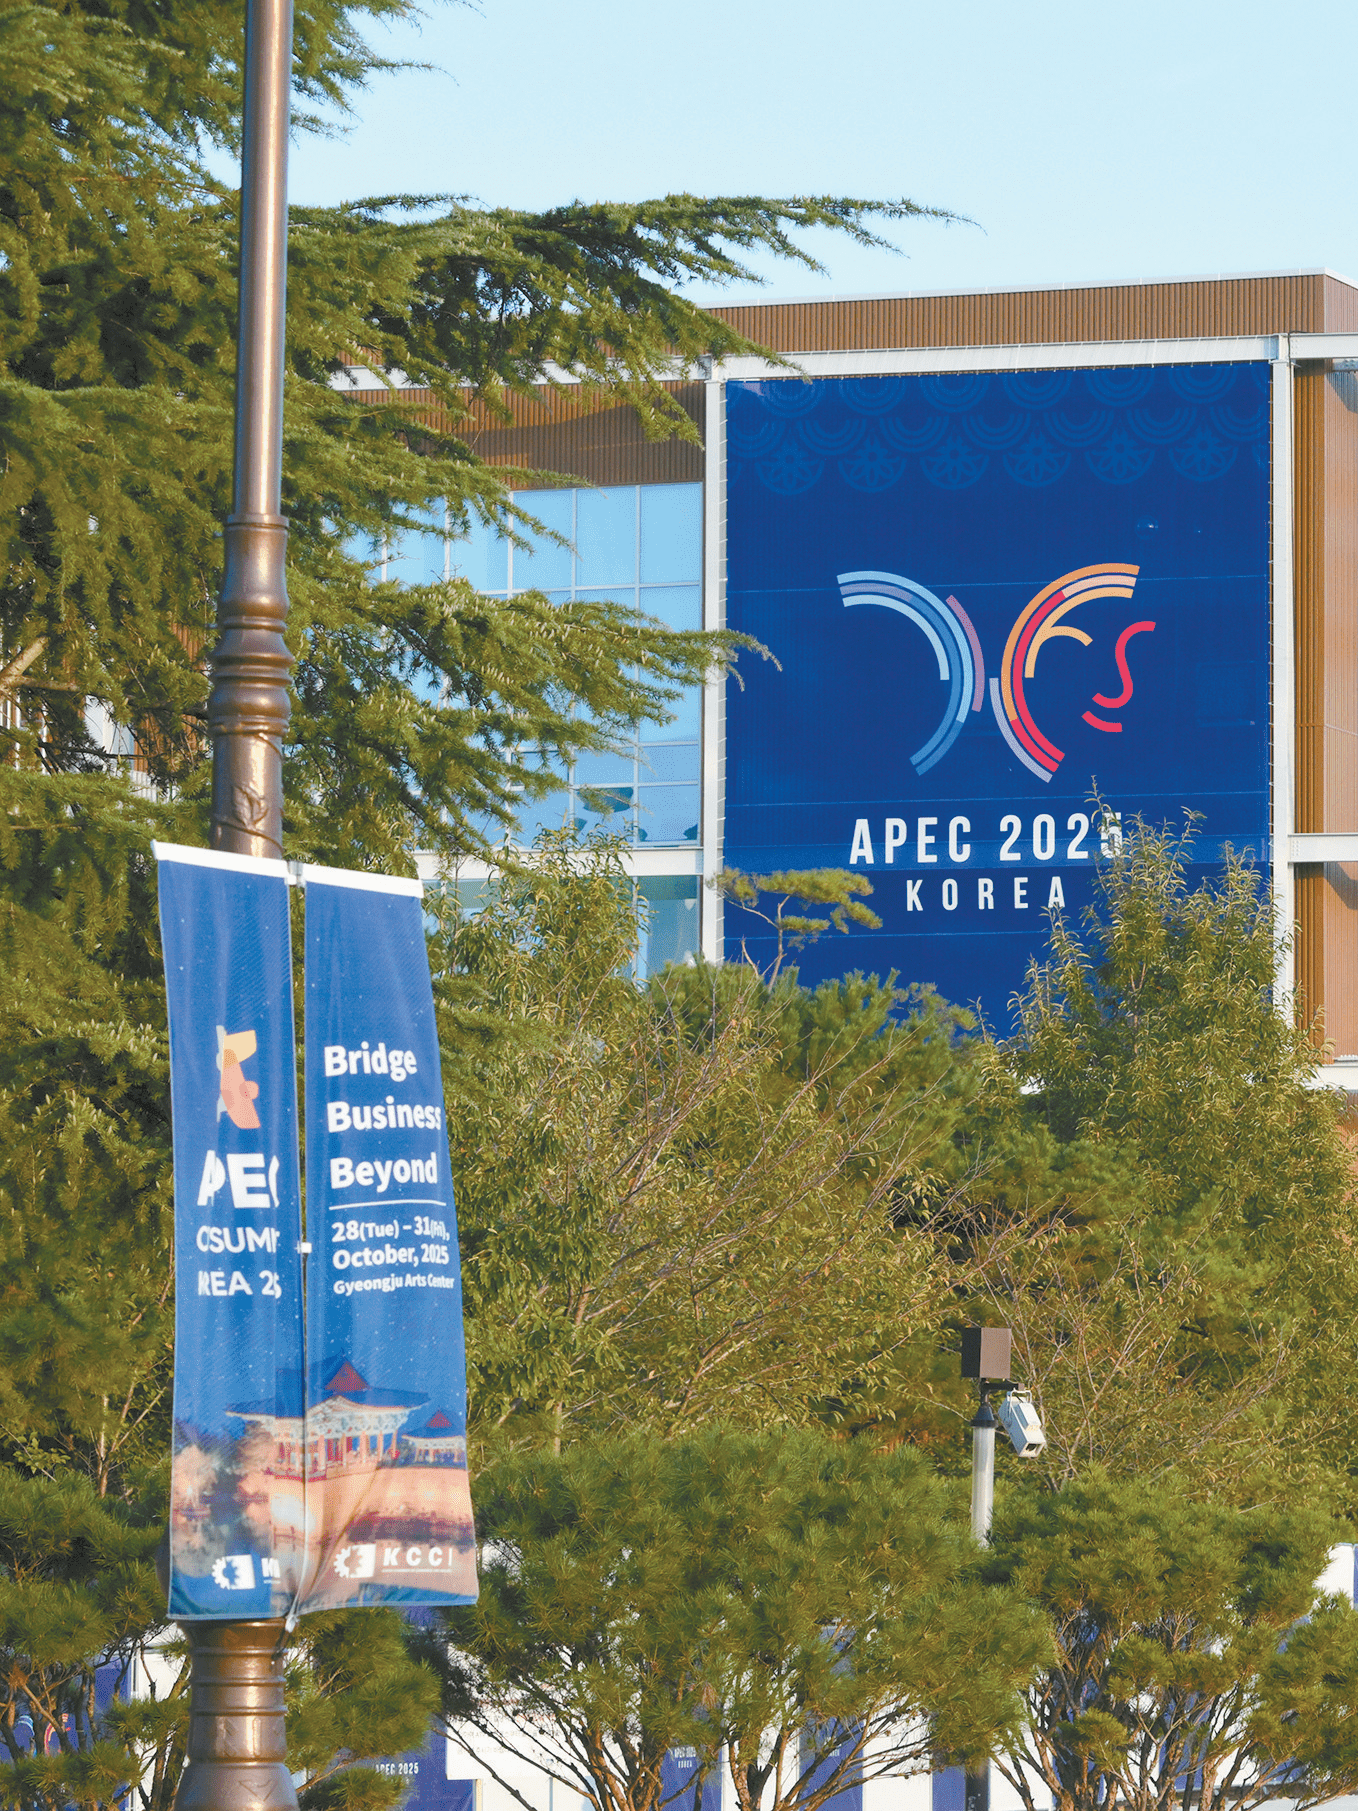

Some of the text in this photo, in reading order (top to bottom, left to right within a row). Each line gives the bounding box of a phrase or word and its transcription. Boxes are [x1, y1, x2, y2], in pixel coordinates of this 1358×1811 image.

[849, 811, 1122, 865] APEC 2025
[906, 875, 1067, 912] KOREA
[324, 1040, 418, 1082] Bridge
[326, 1095, 442, 1133] Business
[330, 1151, 438, 1193] Beyond
[331, 1219, 400, 1242] 28(Tue)
[332, 1243, 450, 1270] October, 2025
[333, 1272, 455, 1296] Gyeongju Arts Center
[398, 1762, 419, 1775] 2025
